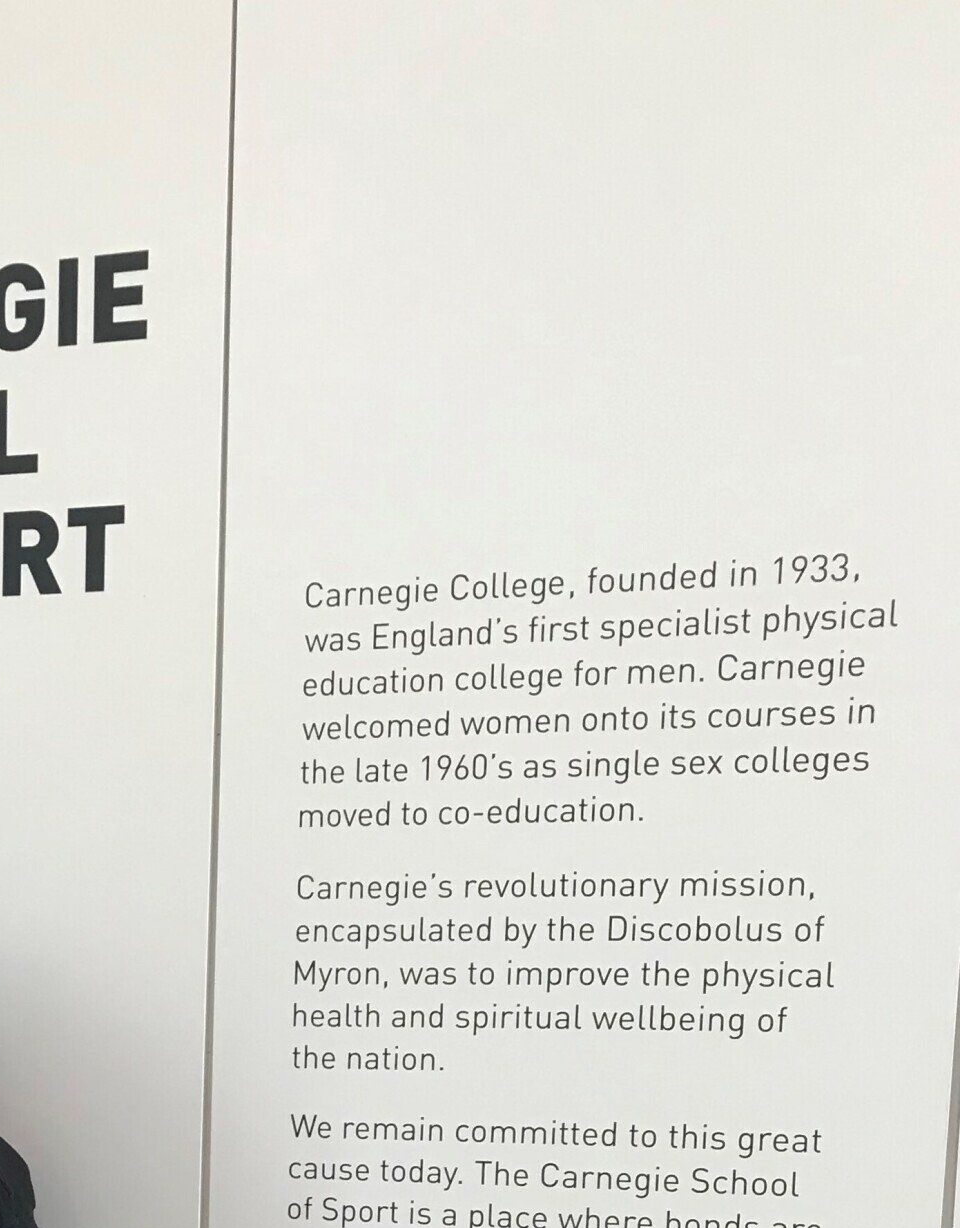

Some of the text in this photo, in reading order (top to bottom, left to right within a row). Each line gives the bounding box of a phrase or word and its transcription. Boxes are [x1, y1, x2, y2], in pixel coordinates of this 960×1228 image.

[305, 552, 860, 612] Carnegie College, founded in 1933,
[304, 598, 899, 656] was England's first specialist physical
[302, 648, 866, 698] education college for men. Carnegie
[301, 696, 876, 741] welcomed women onto its courses in
[300, 745, 870, 785] the late 1960's as single sex colleges
[298, 795, 644, 829] moved to co-education.
[297, 869, 815, 907] Carnegie's revolutionary mission,
[295, 914, 826, 950] encapsulated by the Discobolus of
[293, 959, 835, 995] Myron, was to improve the physical
[292, 1002, 789, 1040] health and spiritual wellbeing of
[291, 1044, 444, 1072] the nation.
[290, 1113, 823, 1160] We remain committed to this great
[288, 1158, 800, 1200] cause today. The Carnegie School
[287, 1196, 314, 1221] of
[321, 1196, 399, 1228] Sport
[409, 1199, 432, 1226] is
[441, 1208, 457, 1227] a
